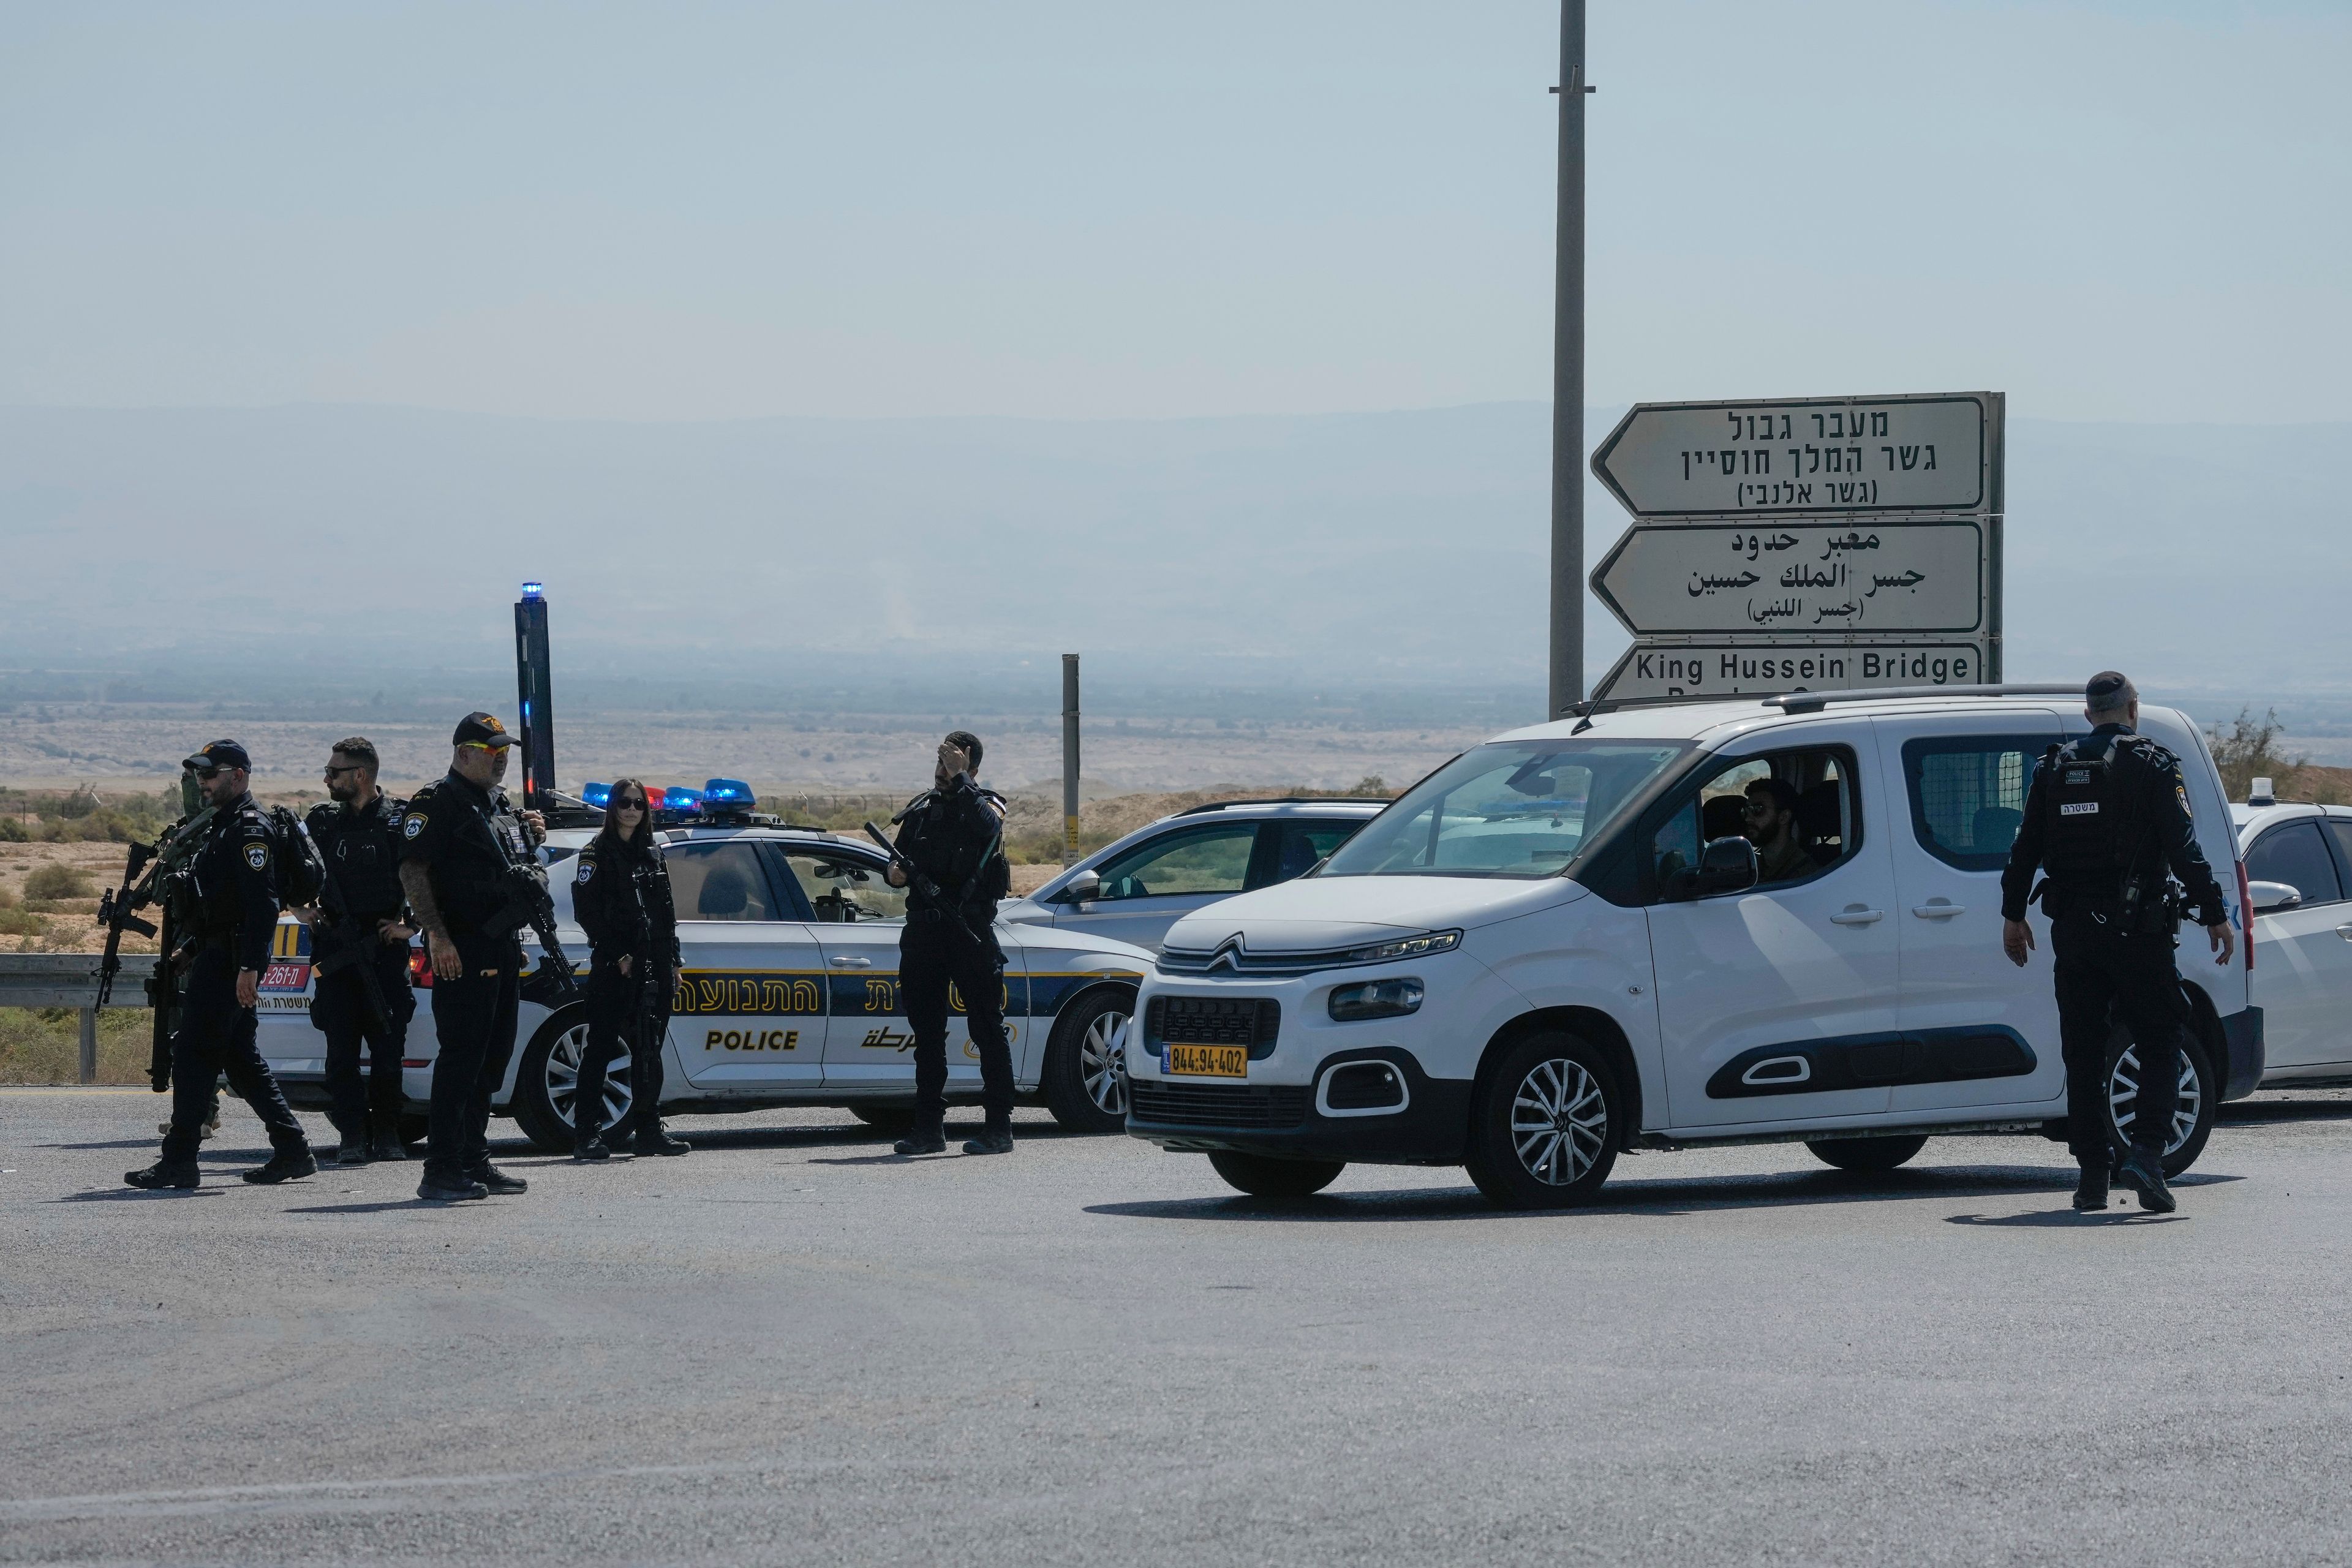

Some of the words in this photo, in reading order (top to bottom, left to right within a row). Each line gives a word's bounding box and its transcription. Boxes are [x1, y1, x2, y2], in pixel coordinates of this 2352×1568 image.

[1728, 412, 1791, 440] גבול
[1812, 411, 1887, 438] מעבר
[1682, 450, 1769, 480] חוסיין
[1789, 444, 1861, 478] המלך
[1882, 445, 1936, 470] גשר
[1738, 481, 1811, 507] אלנבי)
[1826, 480, 1877, 504] (גשר
[1732, 533, 1799, 561] حدود
[1820, 533, 1880, 560] معبر
[1688, 571, 1760, 597] حسين
[1781, 563, 1845, 587] الملك
[1865, 570, 1925, 597] جسر
[1748, 598, 1801, 622] اللنبي)
[1813, 598, 1863, 624] (جسر
[1638, 655, 1702, 685] King
[1721, 654, 1843, 678] Hussein
[1864, 653, 1967, 684] Bridge
[2064, 804, 2095, 813] משטרה
[673, 979, 819, 1012] התנועה
[704, 1030, 800, 1051] POLICE
